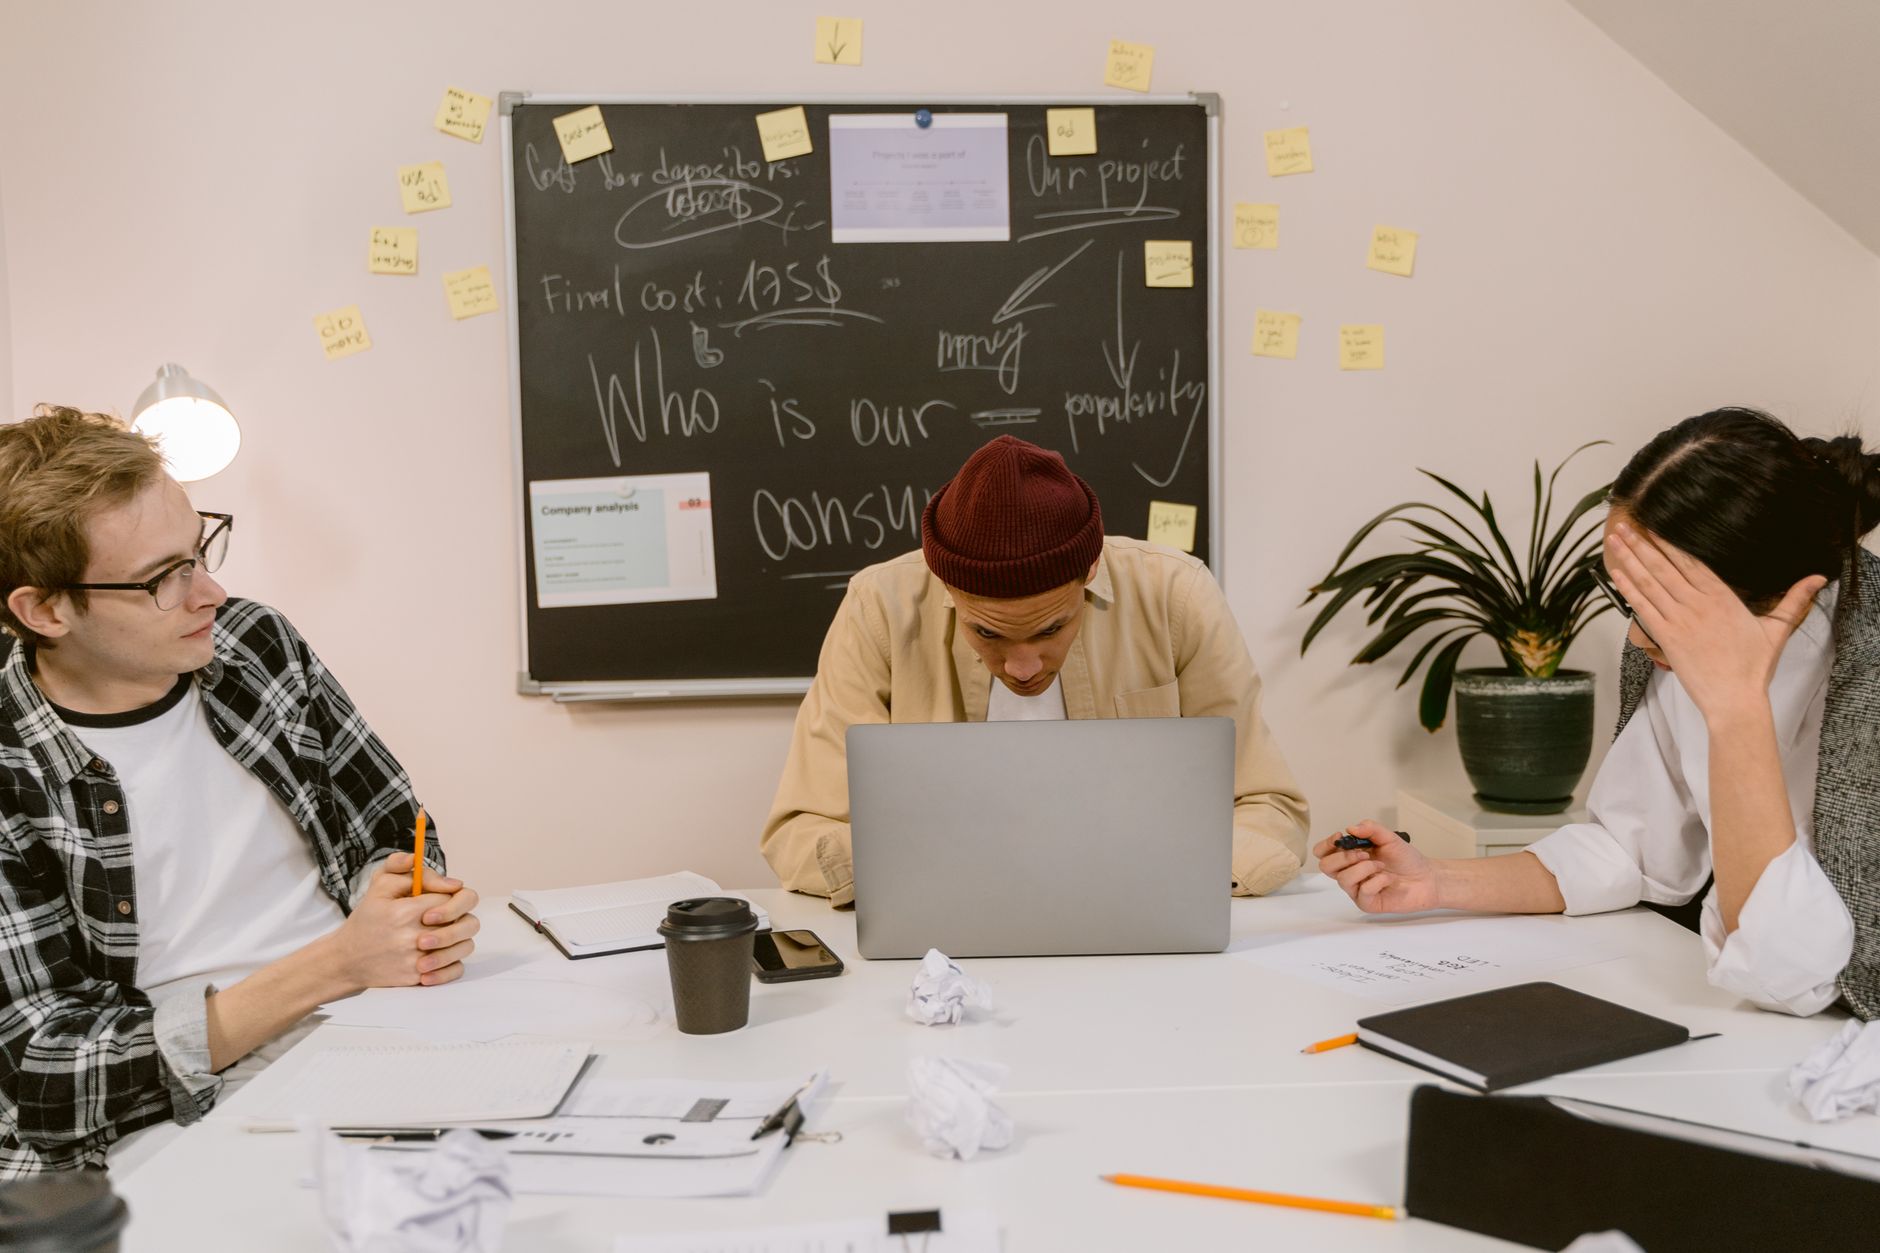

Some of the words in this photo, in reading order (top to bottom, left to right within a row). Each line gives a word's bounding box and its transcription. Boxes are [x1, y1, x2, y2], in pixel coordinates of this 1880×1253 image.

[1027, 135, 1086, 197] Our
[1099, 139, 1185, 216] project
[541, 264, 624, 316] Final
[588, 326, 719, 468] Who
[758, 378, 816, 448] is
[850, 399, 957, 447] our
[541, 504, 592, 517] Company
[595, 501, 639, 514] analysis
